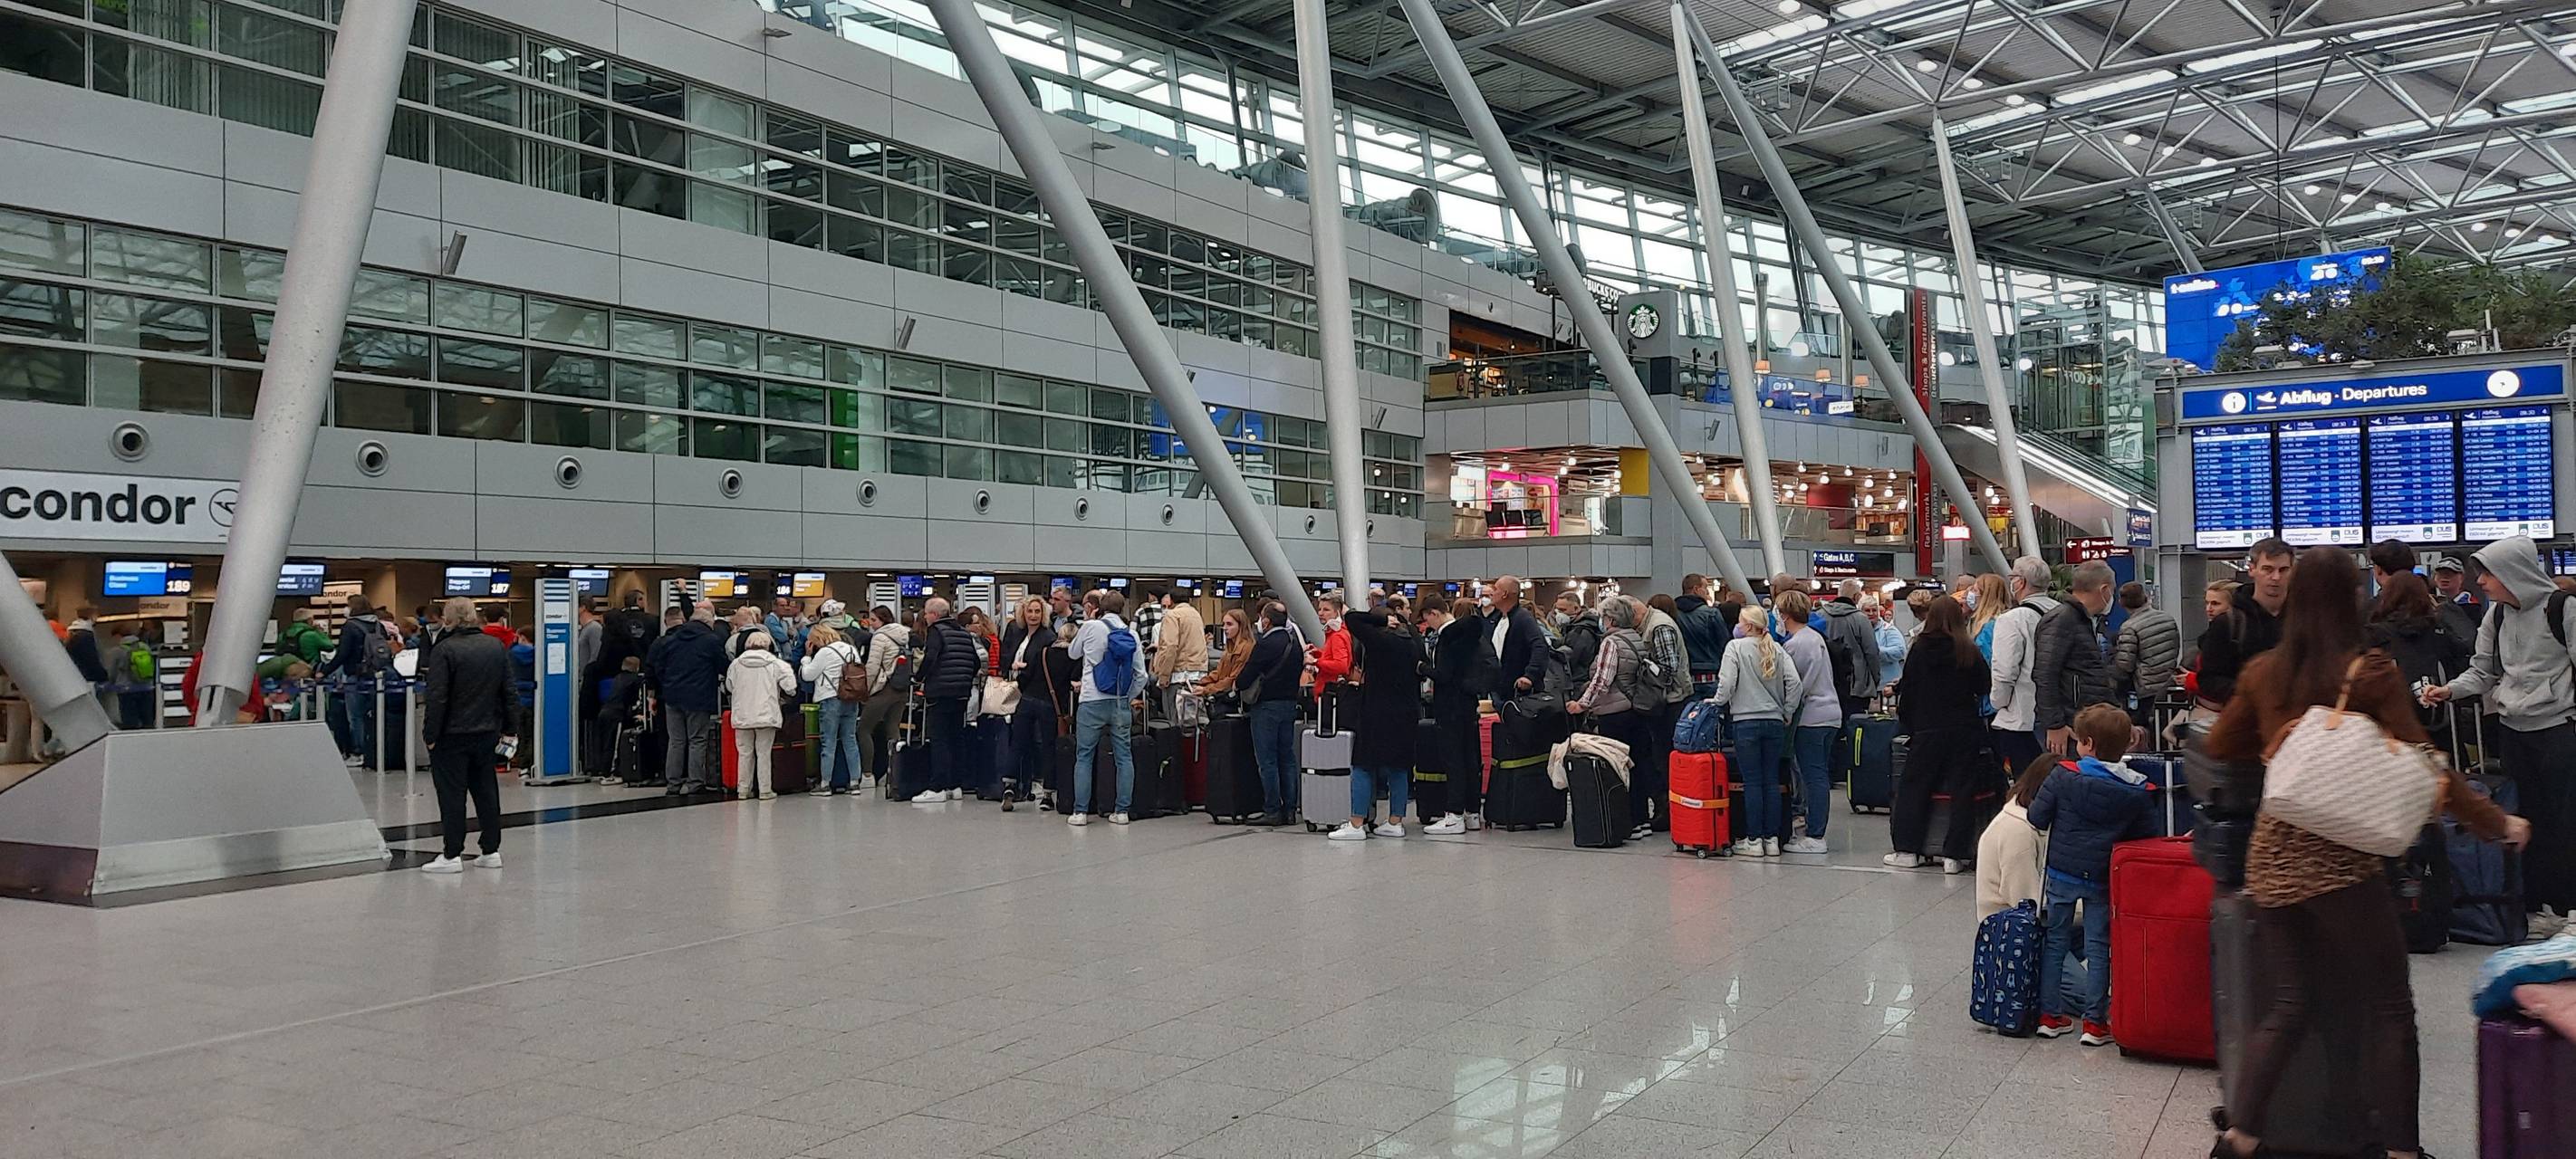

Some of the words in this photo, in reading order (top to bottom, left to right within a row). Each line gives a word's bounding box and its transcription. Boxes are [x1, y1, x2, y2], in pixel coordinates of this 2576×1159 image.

[2279, 389, 2332, 406] Abflug
[2342, 385, 2427, 402] Departures
[0, 484, 196, 524] condor
